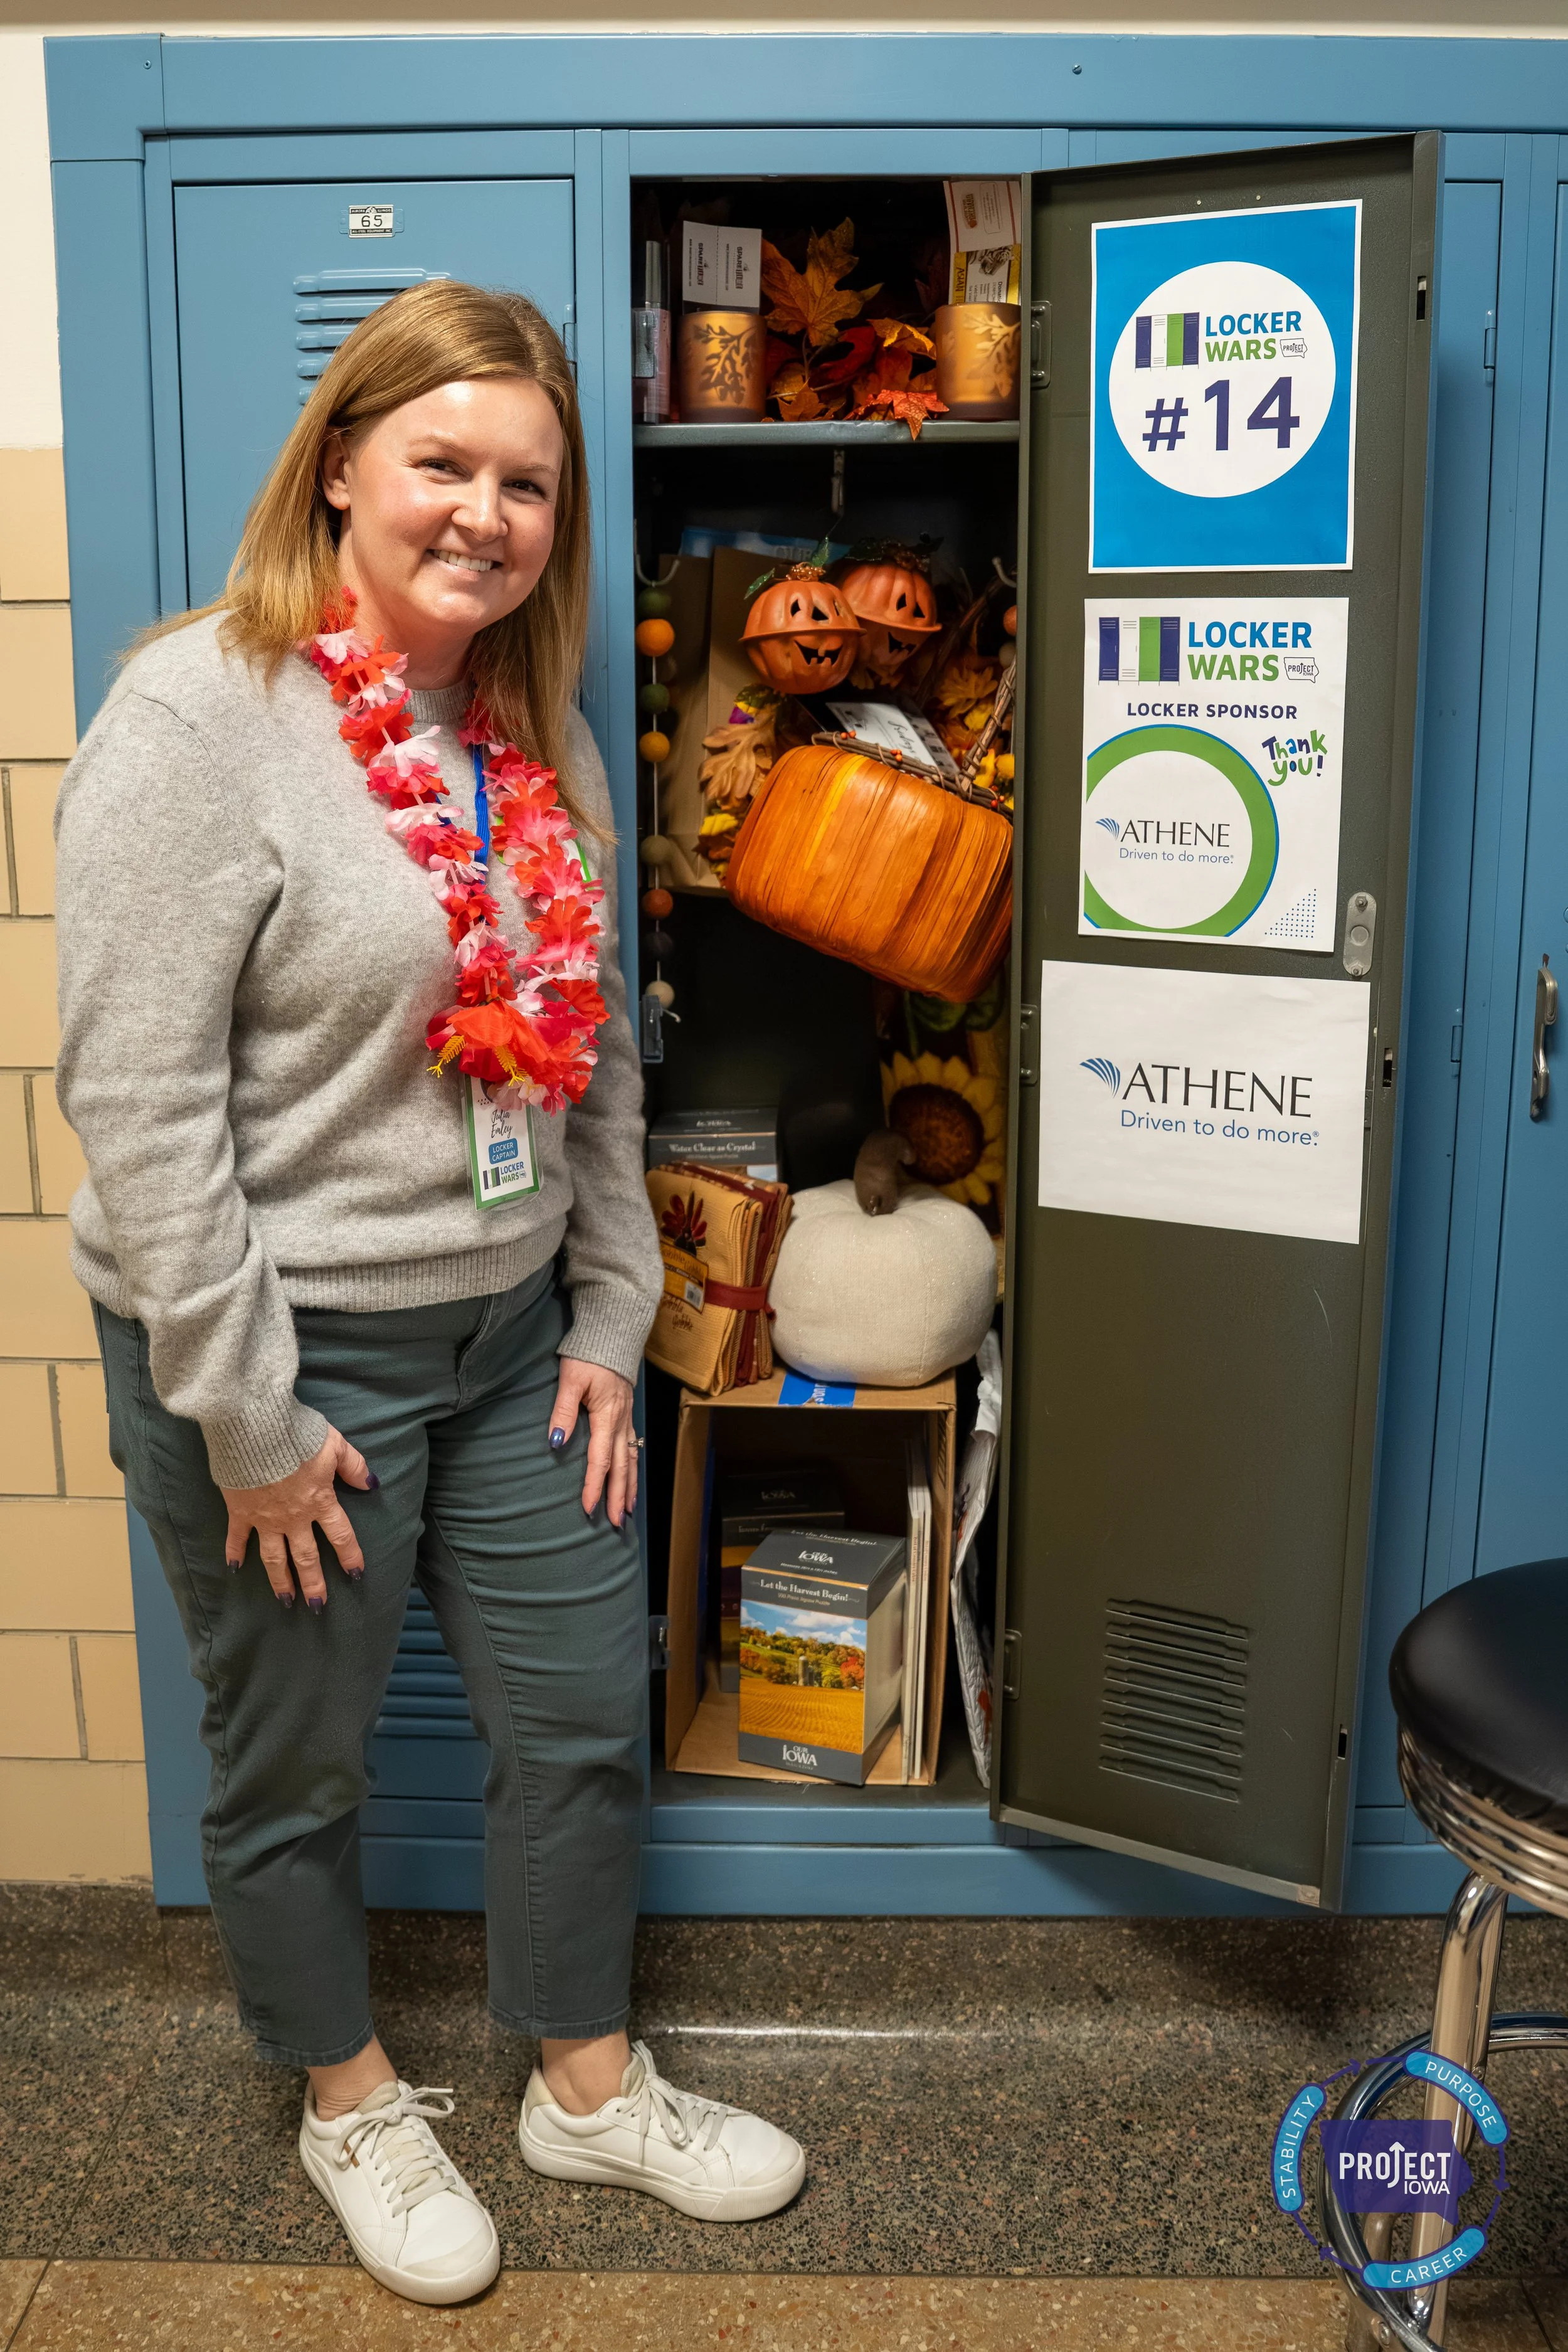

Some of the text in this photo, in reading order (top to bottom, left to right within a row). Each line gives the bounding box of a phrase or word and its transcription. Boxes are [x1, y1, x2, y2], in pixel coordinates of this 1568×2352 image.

[361, 215, 382, 227] 65
[955, 267, 965, 292] ASIAN
[1205, 310, 1301, 337] LOCKER
[1205, 337, 1304, 363] WARS PROJECT
[1142, 376, 1300, 452] #14
[1189, 622, 1312, 649] LOCKER
[1187, 654, 1314, 682] WARS PROJECT
[1127, 702, 1298, 719] LOCKER SPONSOR
[1262, 729, 1328, 761] Thank
[1267, 755, 1323, 787] you!
[1120, 819, 1230, 847] ATHENE
[1120, 847, 1158, 860] Driven
[1162, 851, 1174, 861] to
[1179, 850, 1194, 862] do
[1122, 1062, 1313, 1118] ATHENE
[491, 1120, 514, 1138] Emley
[1121, 1110, 1186, 1133] Driven
[1194, 1118, 1215, 1135] to
[1222, 1120, 1250, 1140] do
[492, 1142, 514, 1153] LOCKER
[492, 1149, 516, 1162] CAPTAIN
[726, 1141, 756, 1152] Crystal
[500, 1161, 524, 1175] LOCKER
[501, 1172, 519, 1184] WARS
[798, 1550, 834, 1564] IOWA
[761, 1579, 849, 1602] Let the Harvest Begin!
[782, 1744, 818, 1766] IOWA
[793, 1745, 808, 1754] OUR
